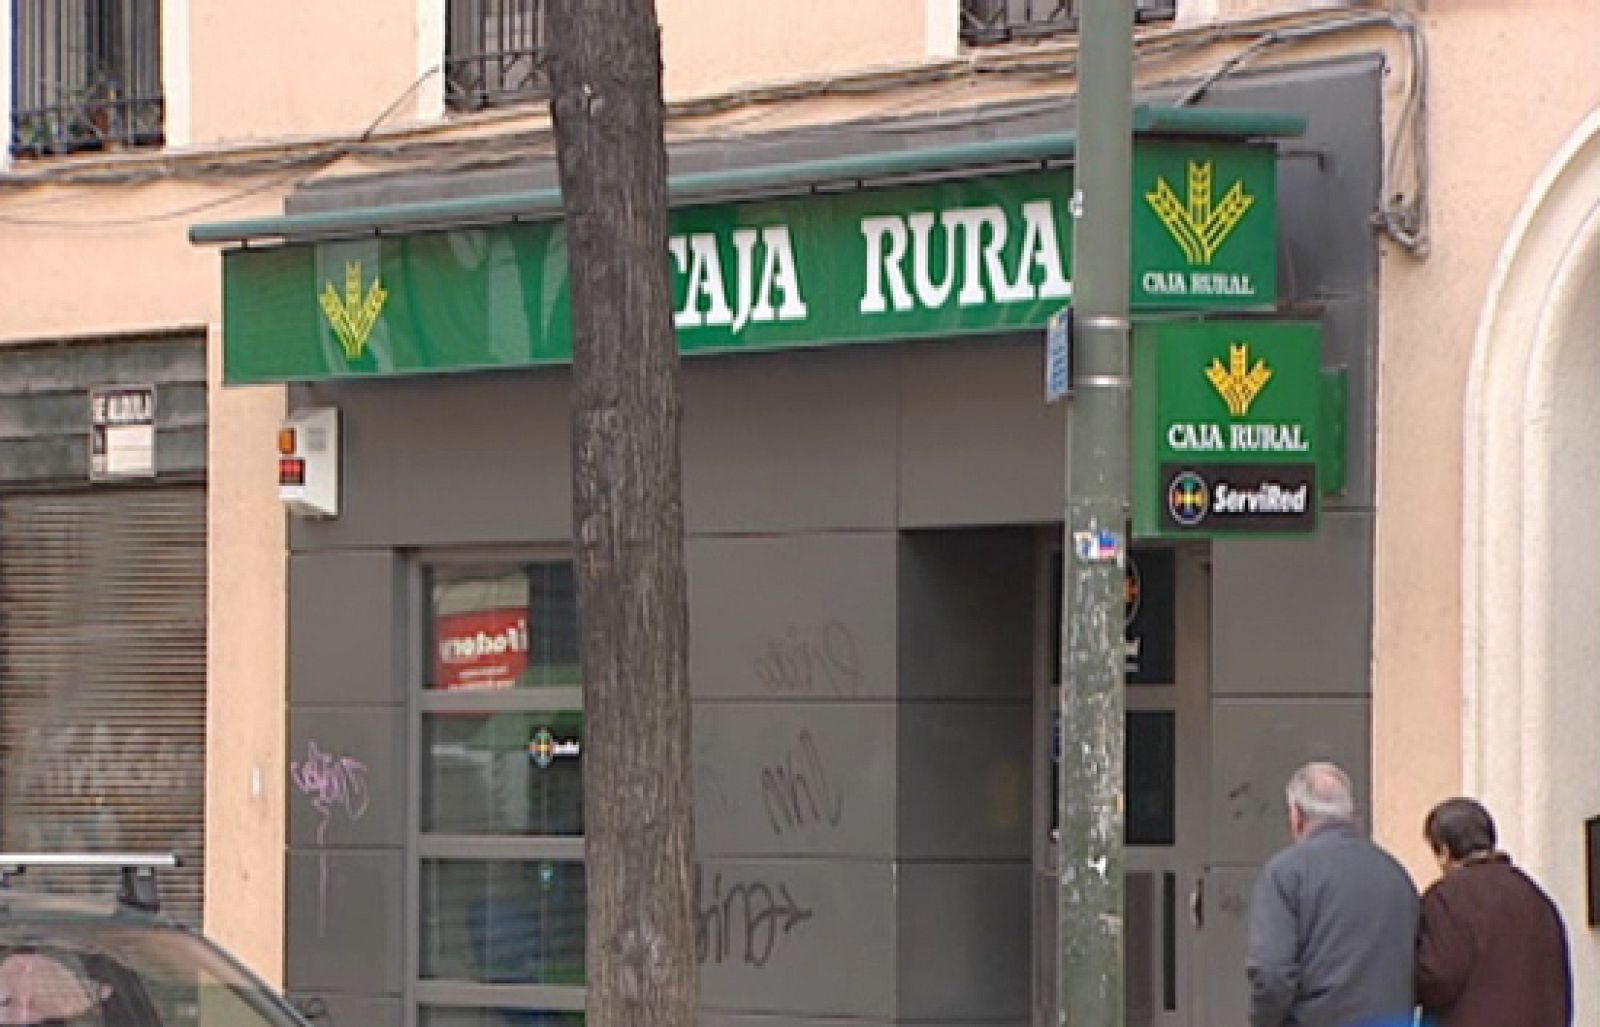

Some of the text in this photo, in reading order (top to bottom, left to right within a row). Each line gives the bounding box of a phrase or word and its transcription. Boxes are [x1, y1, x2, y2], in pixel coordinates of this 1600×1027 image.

[861, 198, 1073, 314] RURA
[1143, 272, 1255, 295] CAJA RURAL
[1168, 424, 1309, 451] CAJA RURAL
[1213, 482, 1307, 513] ServiRed
